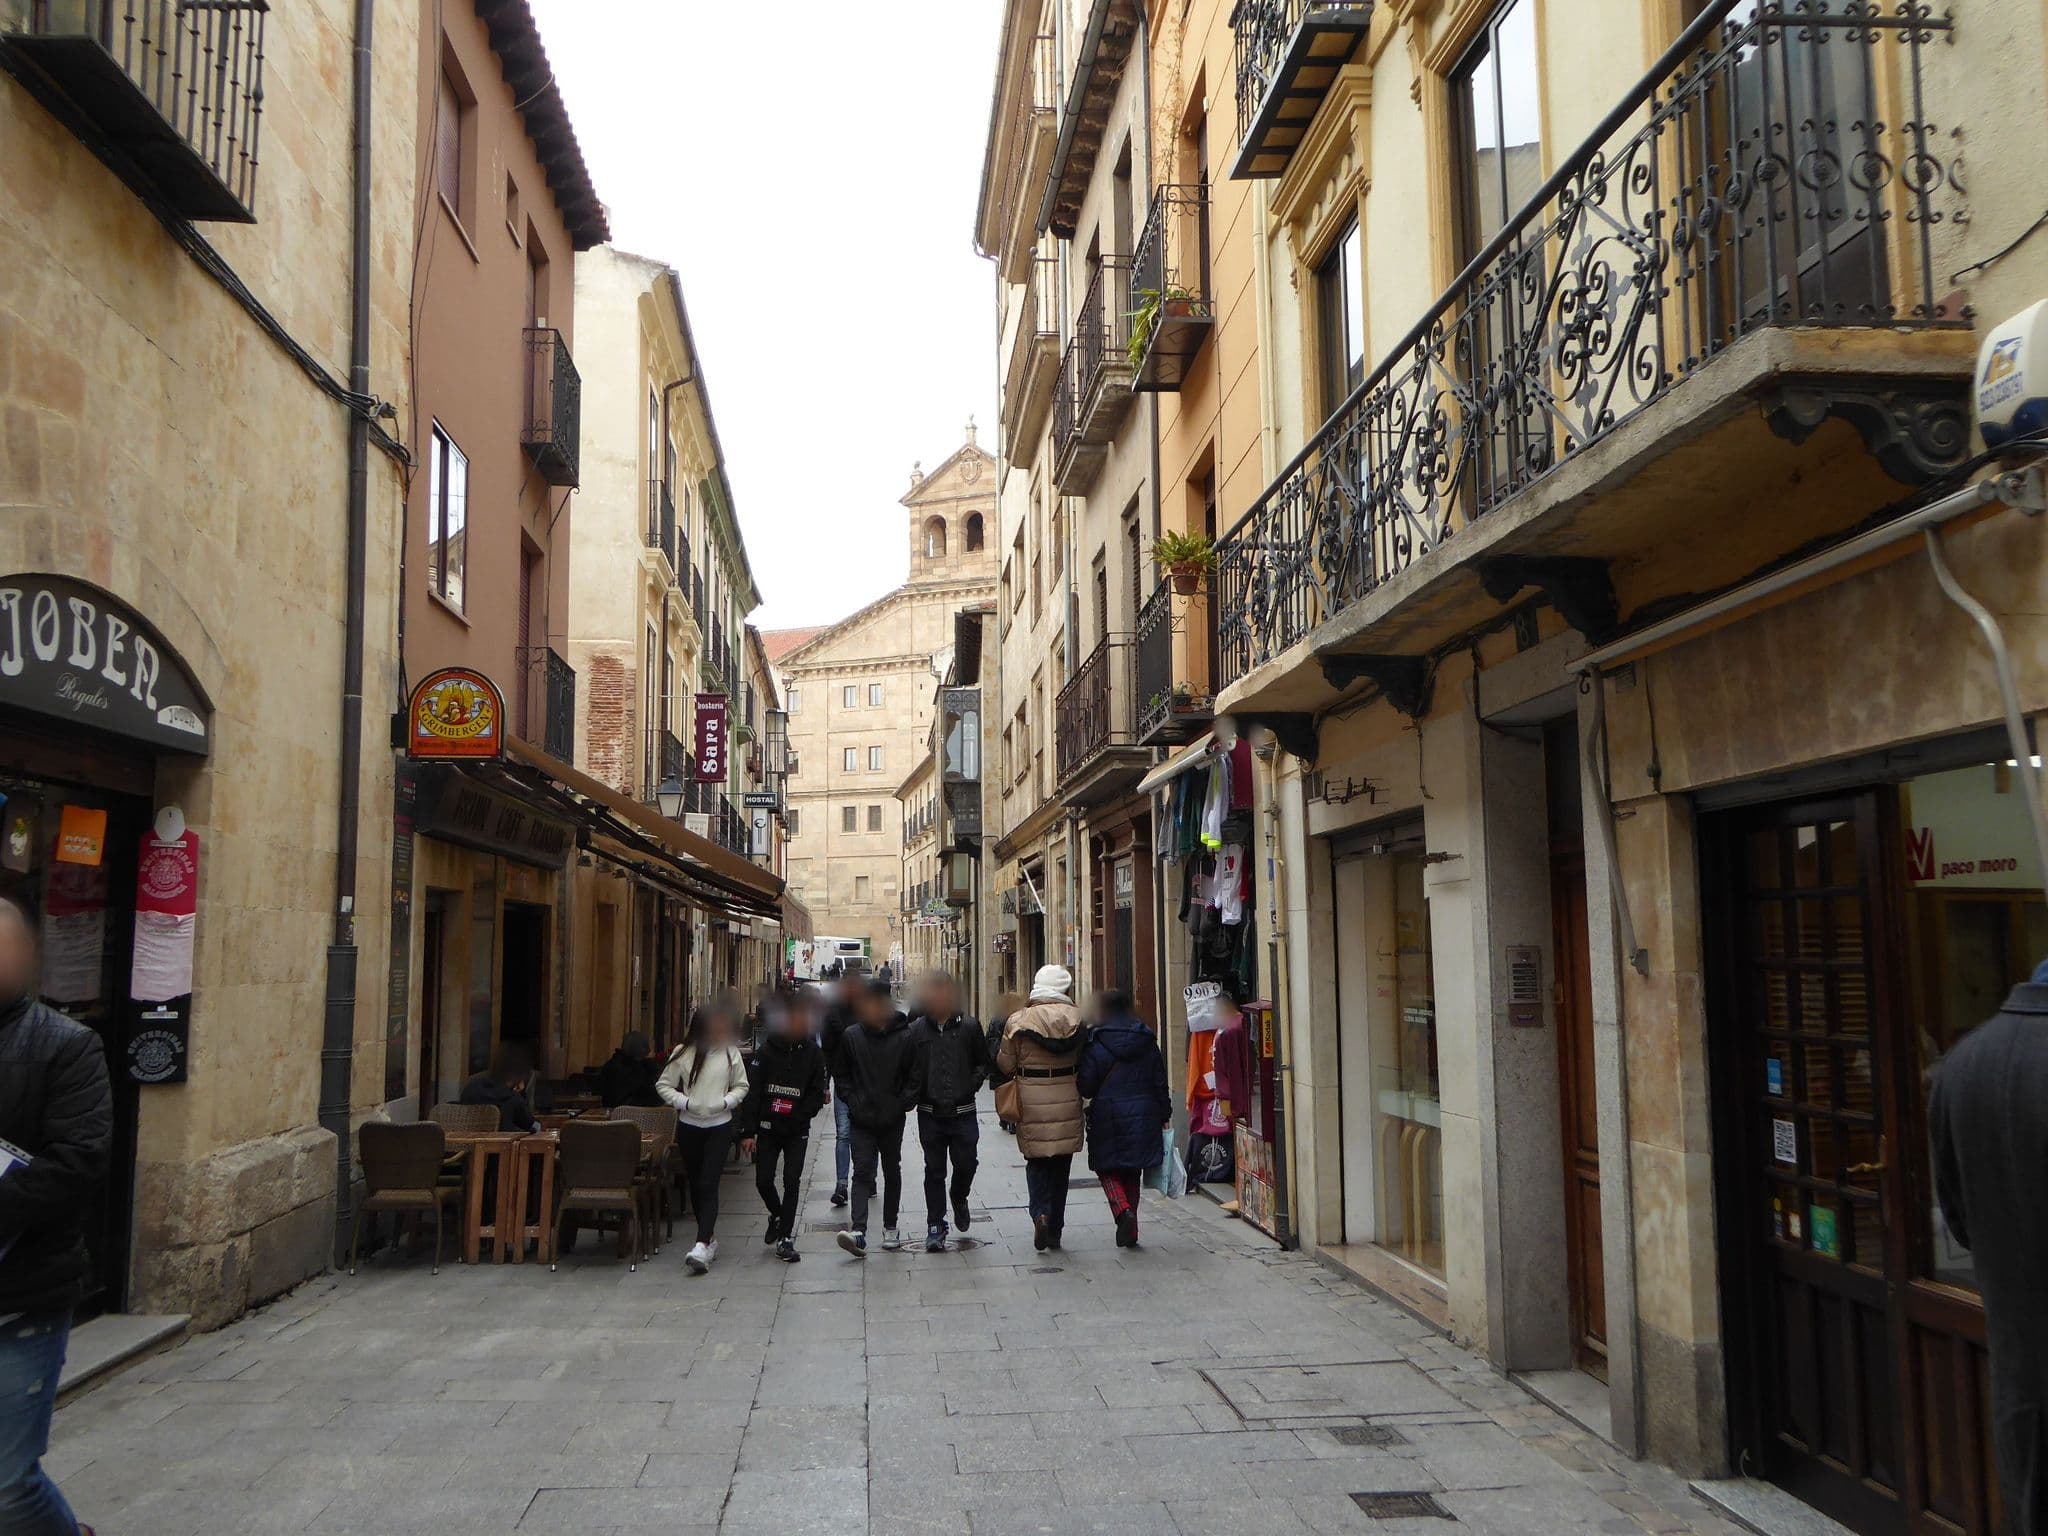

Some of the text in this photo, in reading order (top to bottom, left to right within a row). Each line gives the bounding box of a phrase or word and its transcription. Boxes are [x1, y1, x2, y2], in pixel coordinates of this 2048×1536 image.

[420, 713, 490, 737] GRIMBERGEN
[703, 718, 719, 774] Sara
[745, 796, 775, 804] HOSTAL
[1940, 857, 2018, 879] paco moro
[1184, 985, 1210, 1000] 9.90
